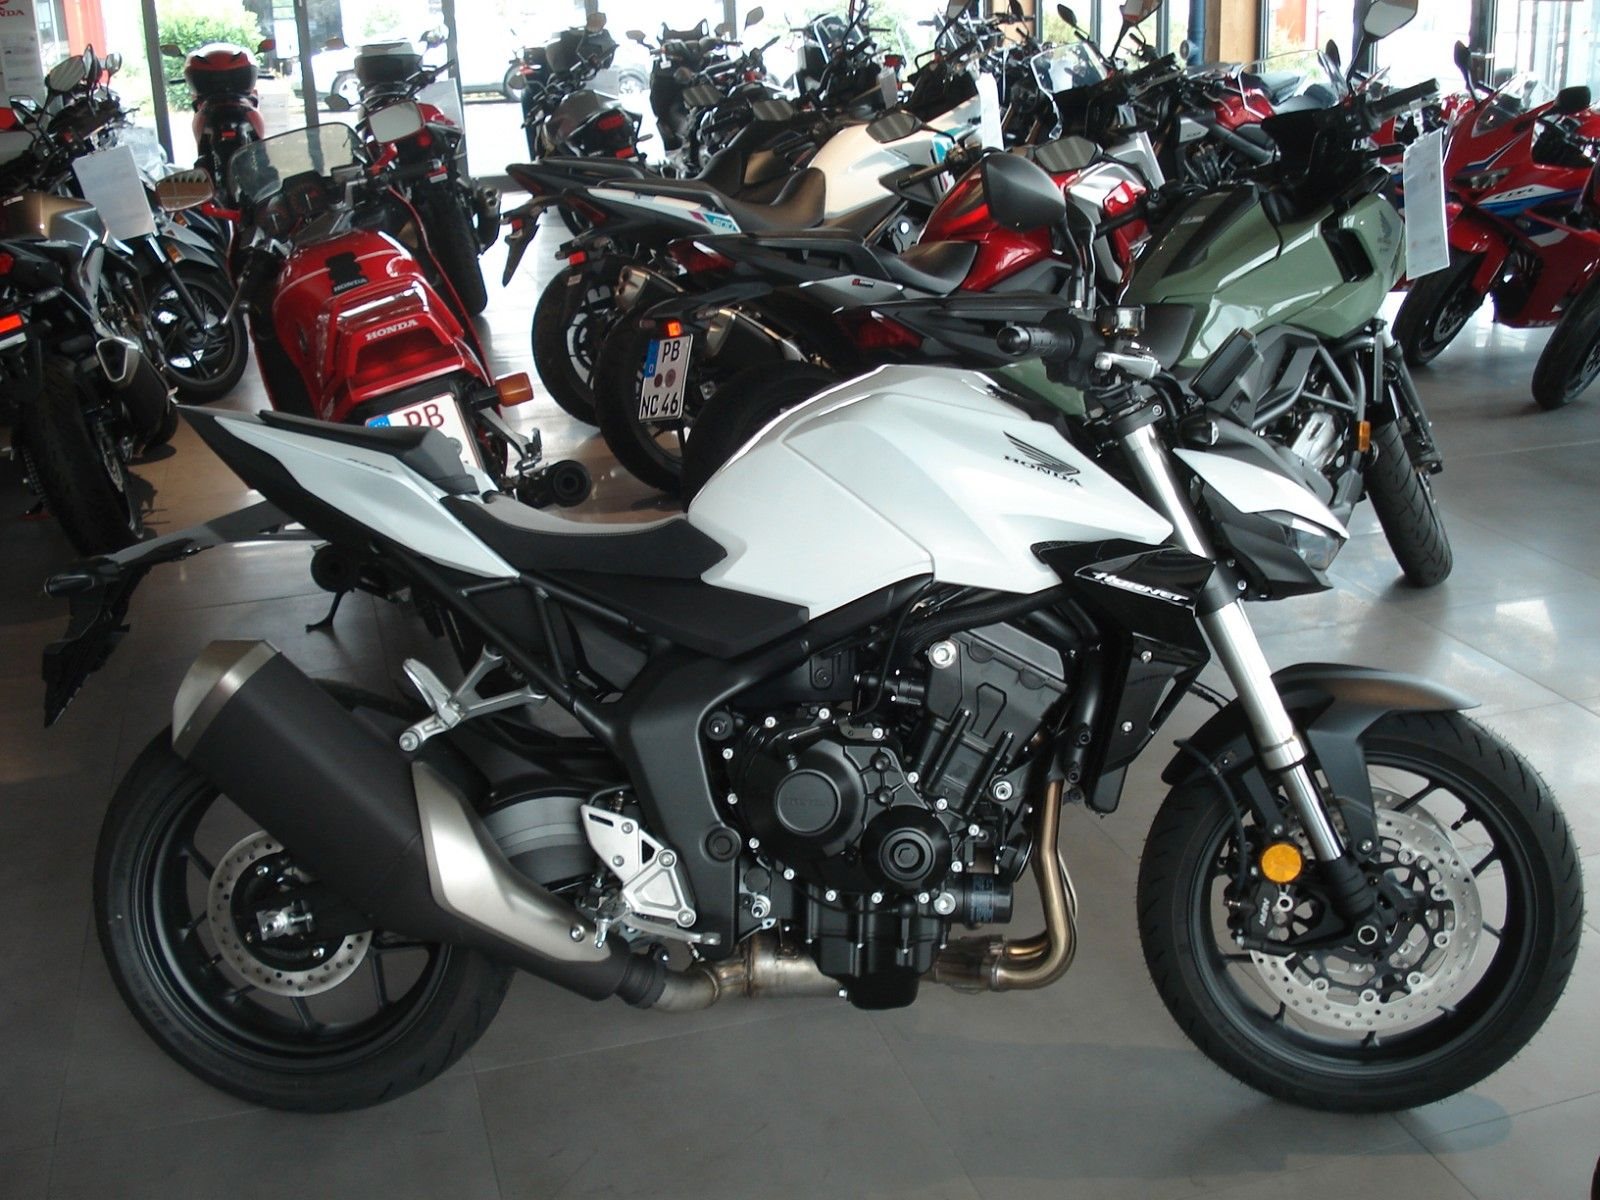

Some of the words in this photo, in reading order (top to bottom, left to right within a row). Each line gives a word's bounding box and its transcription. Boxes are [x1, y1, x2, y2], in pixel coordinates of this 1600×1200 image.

[333, 278, 367, 292] HONDA
[365, 319, 419, 341] HONDA
[662, 340, 681, 362] PB
[403, 403, 445, 429] PB
[641, 395, 660, 417] NC
[661, 392, 679, 415] 46
[1003, 454, 1084, 488] HONDA
